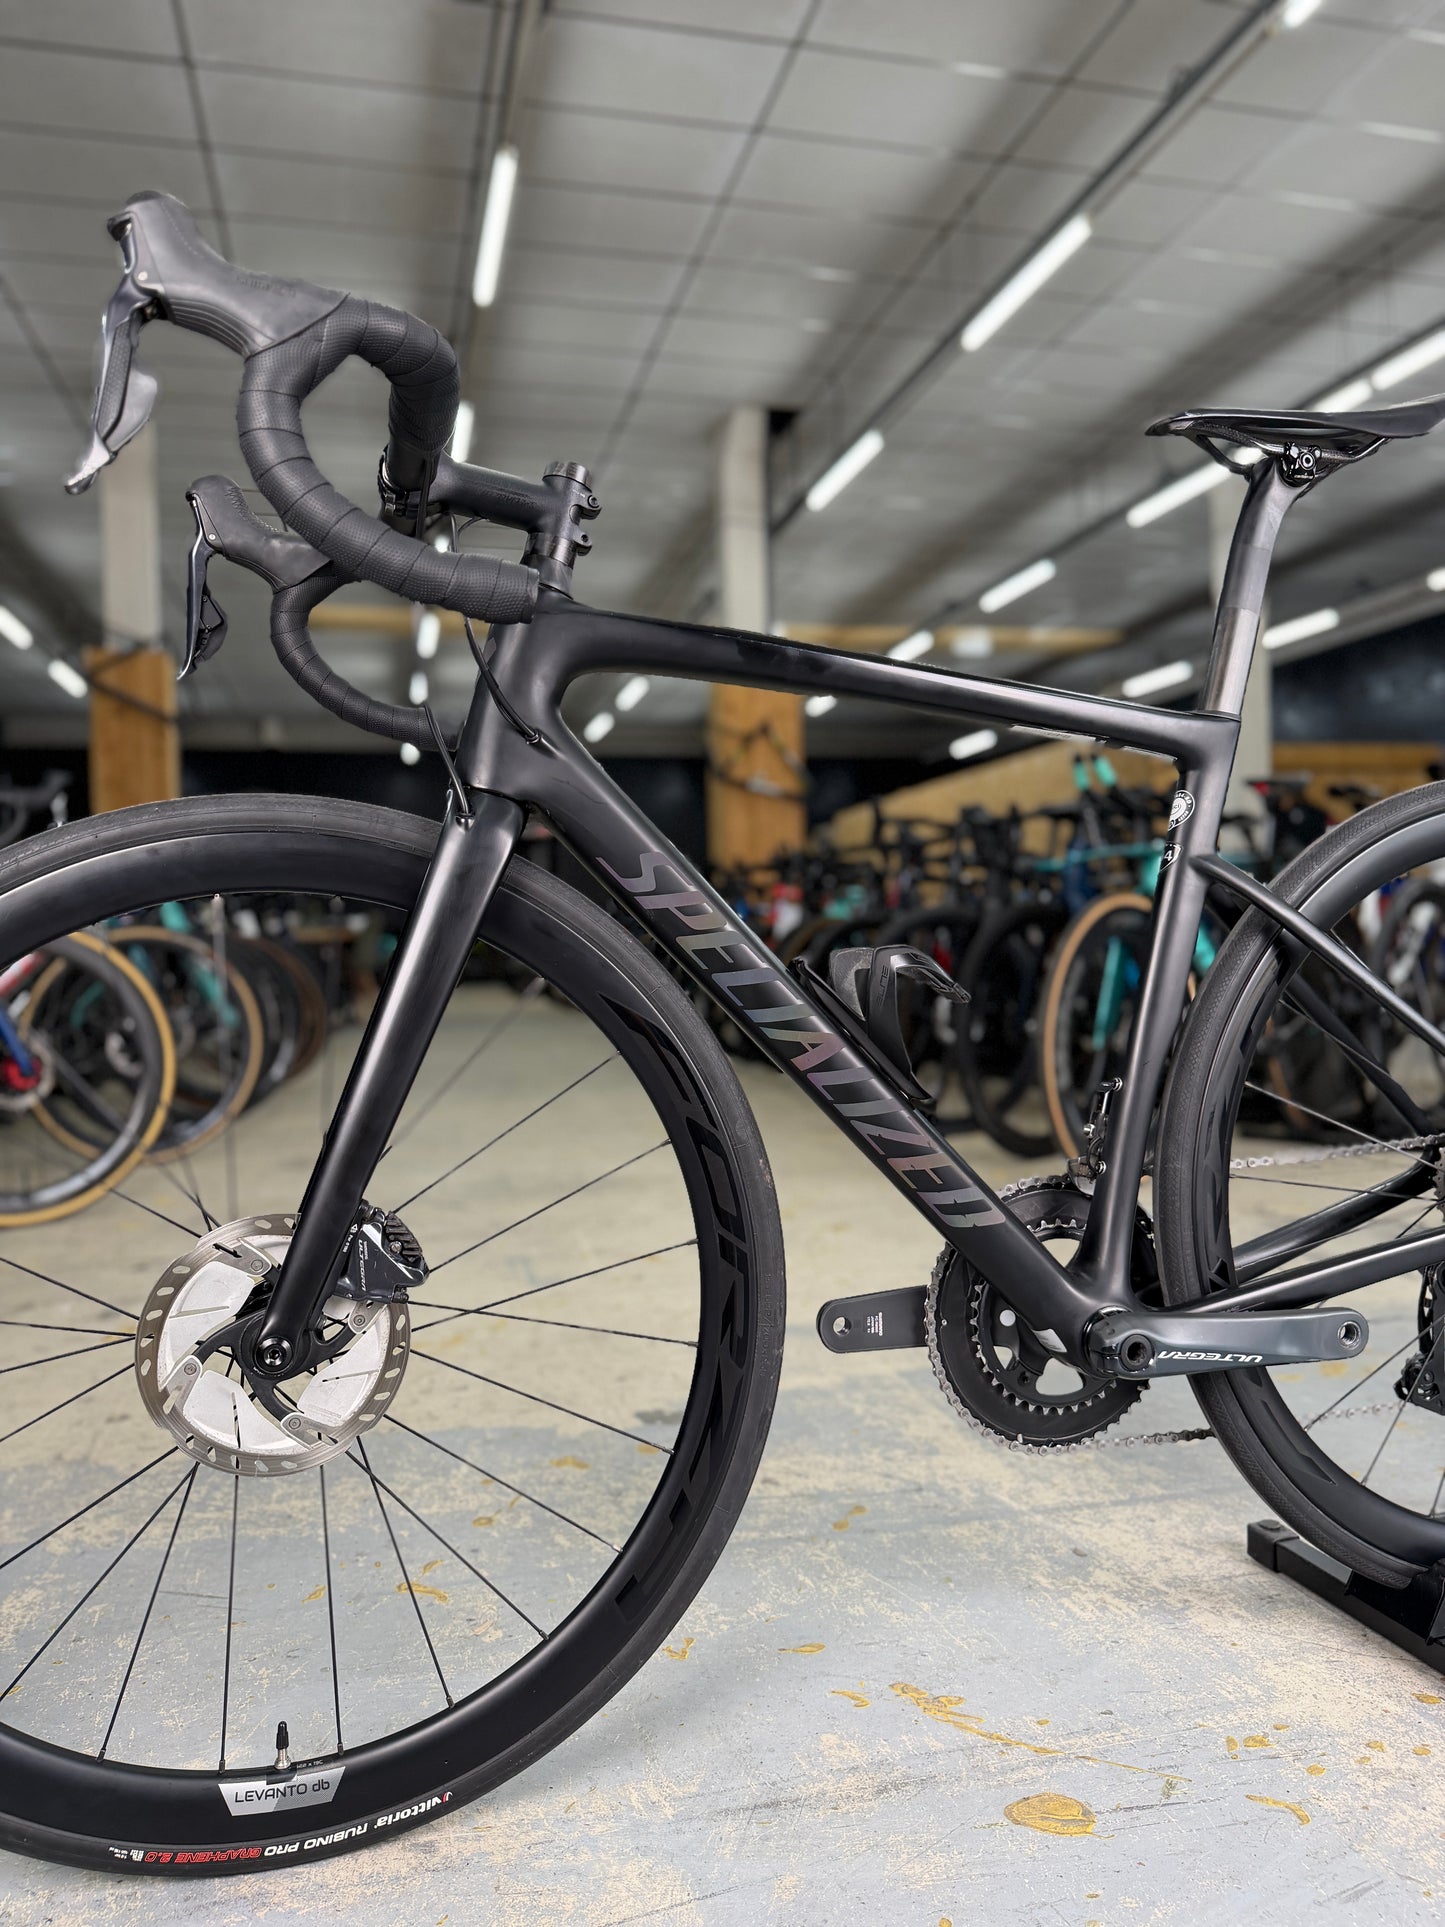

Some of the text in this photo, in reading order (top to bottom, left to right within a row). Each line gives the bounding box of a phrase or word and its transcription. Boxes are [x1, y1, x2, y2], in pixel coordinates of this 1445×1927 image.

[596, 851, 1006, 1228] SPECIALIZED
[359, 1239, 367, 1292] ULTEGRA
[599, 998, 749, 1621] FORZA
[1157, 1350, 1263, 1364] ULTEGRA
[234, 1779, 330, 1803] LEVANTO db
[376, 1796, 443, 1829] vittoria
[263, 1839, 300, 1858] PRO
[303, 1823, 369, 1851] RUBINO
[144, 1851, 173, 1863] 2.0
[174, 1847, 262, 1864] GRAPHENE
